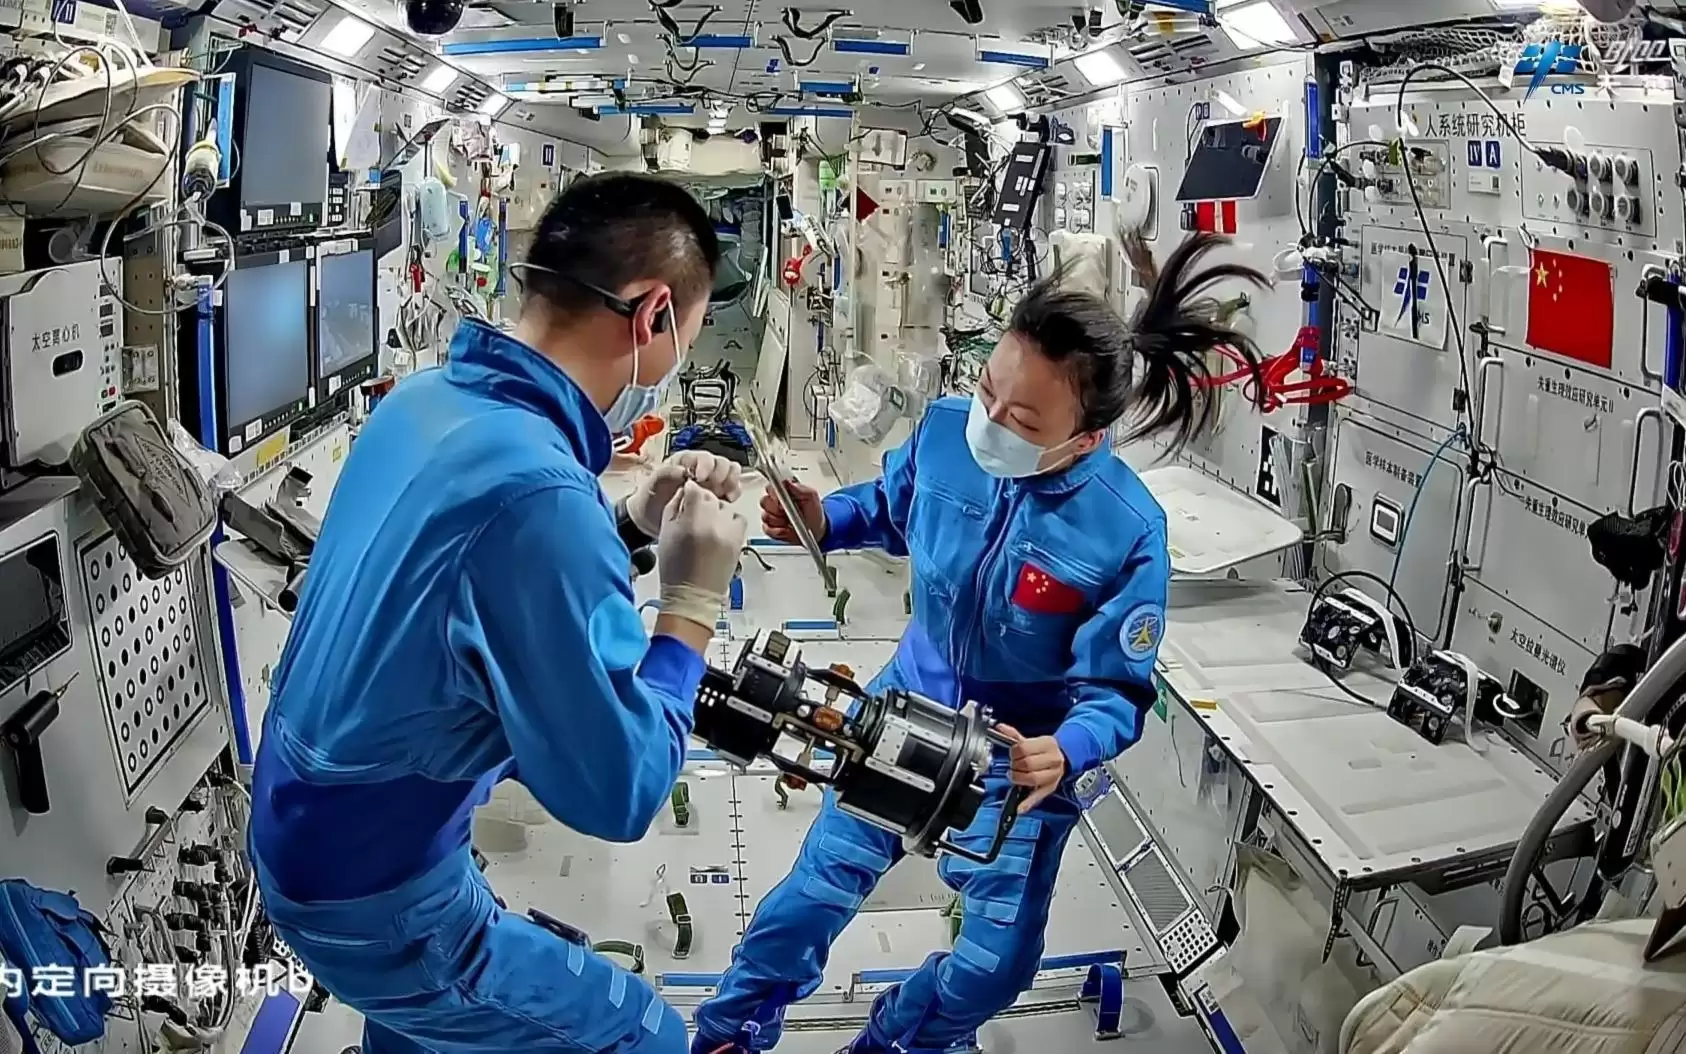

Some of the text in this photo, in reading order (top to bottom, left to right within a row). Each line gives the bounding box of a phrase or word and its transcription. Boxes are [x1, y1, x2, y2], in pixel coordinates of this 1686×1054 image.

[1425, 113, 1527, 138] 人系统研究机柜
[32, 323, 80, 352] 太空离心机
